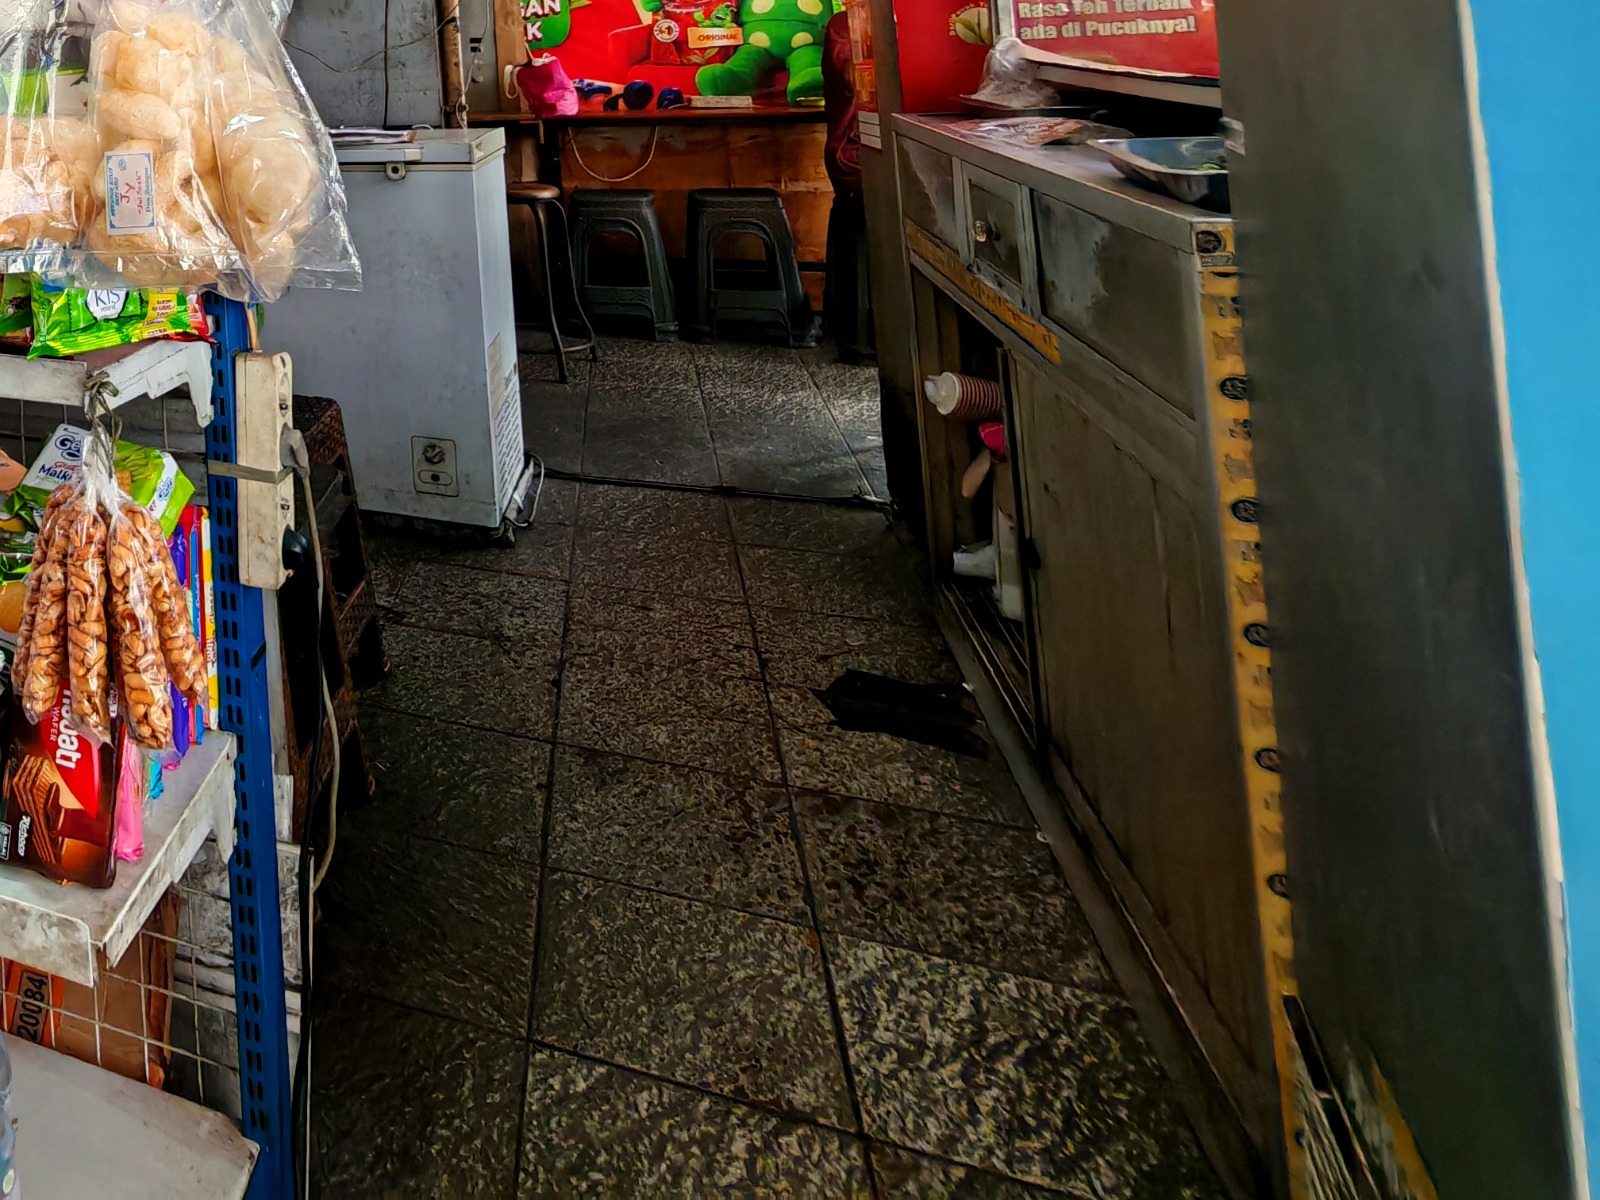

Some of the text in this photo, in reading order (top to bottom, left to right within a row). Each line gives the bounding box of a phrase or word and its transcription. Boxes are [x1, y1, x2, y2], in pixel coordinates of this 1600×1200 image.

[1020, 15, 1198, 40] ada di Pucuknya!
[50, 706, 61, 743] WAFER
